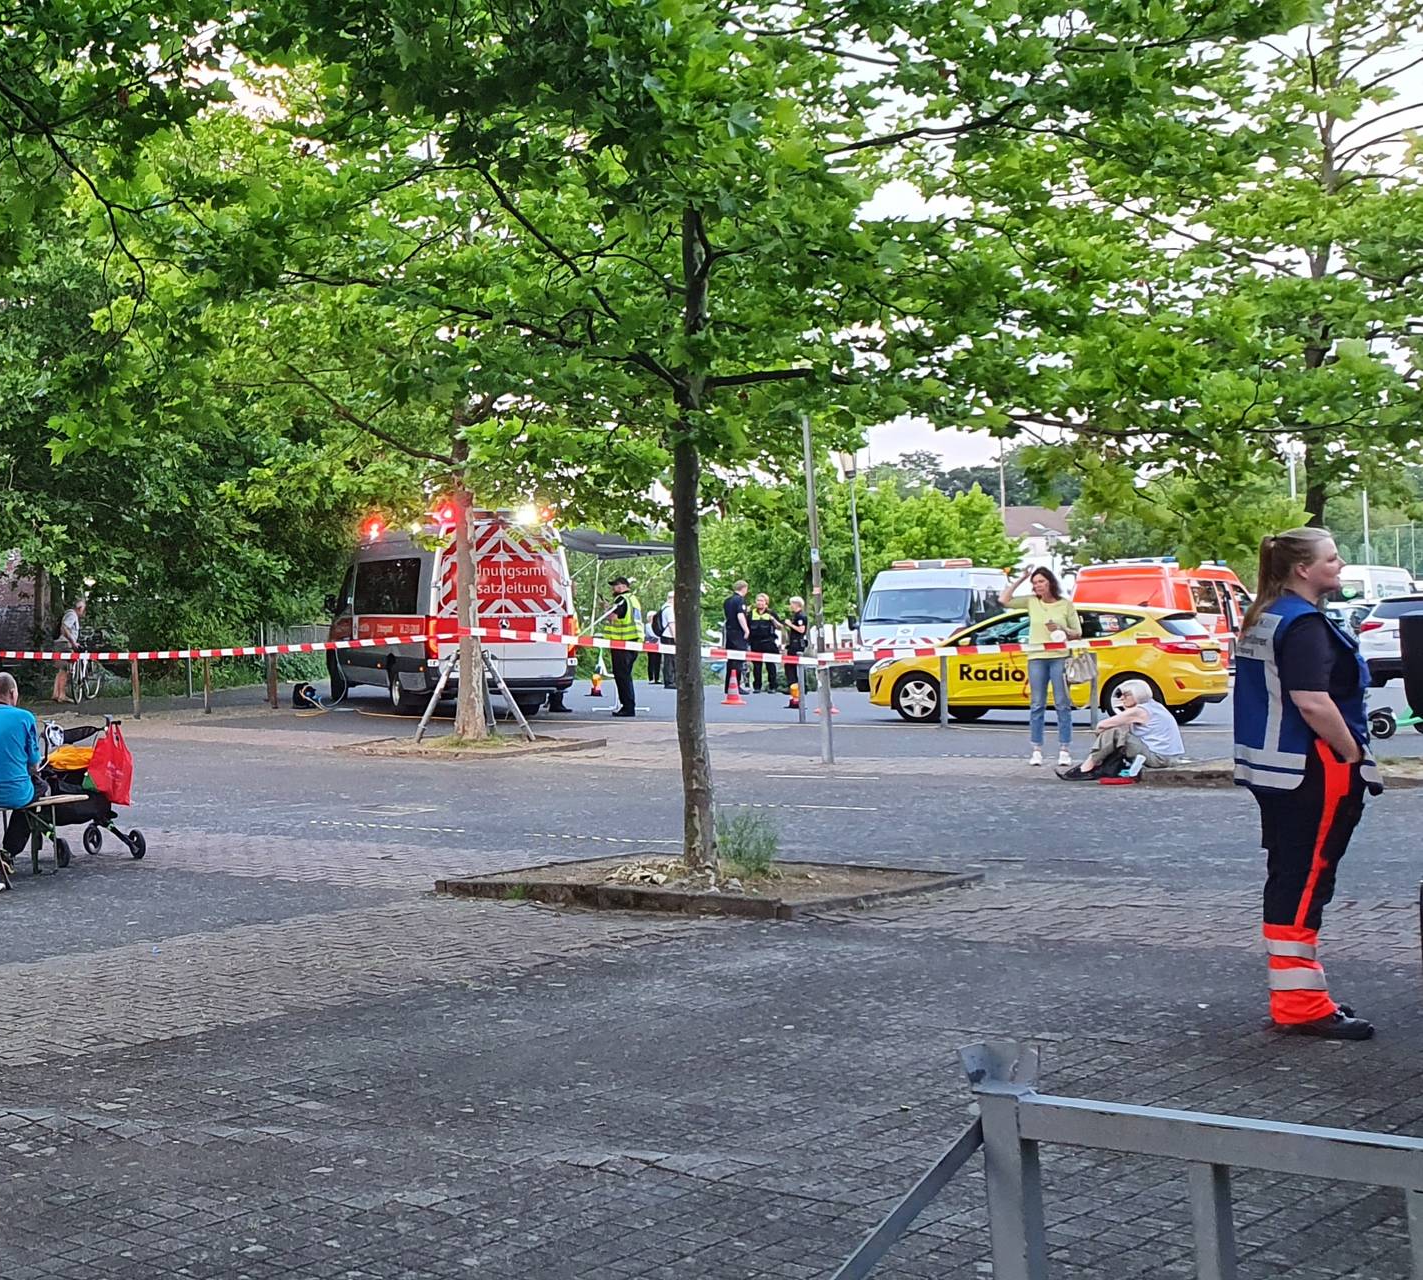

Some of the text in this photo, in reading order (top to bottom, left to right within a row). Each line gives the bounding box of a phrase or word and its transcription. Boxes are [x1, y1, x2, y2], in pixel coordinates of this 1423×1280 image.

[477, 563, 547, 579] dnungsamt
[477, 582, 547, 596] satzleitung
[959, 662, 1026, 682] Radio
